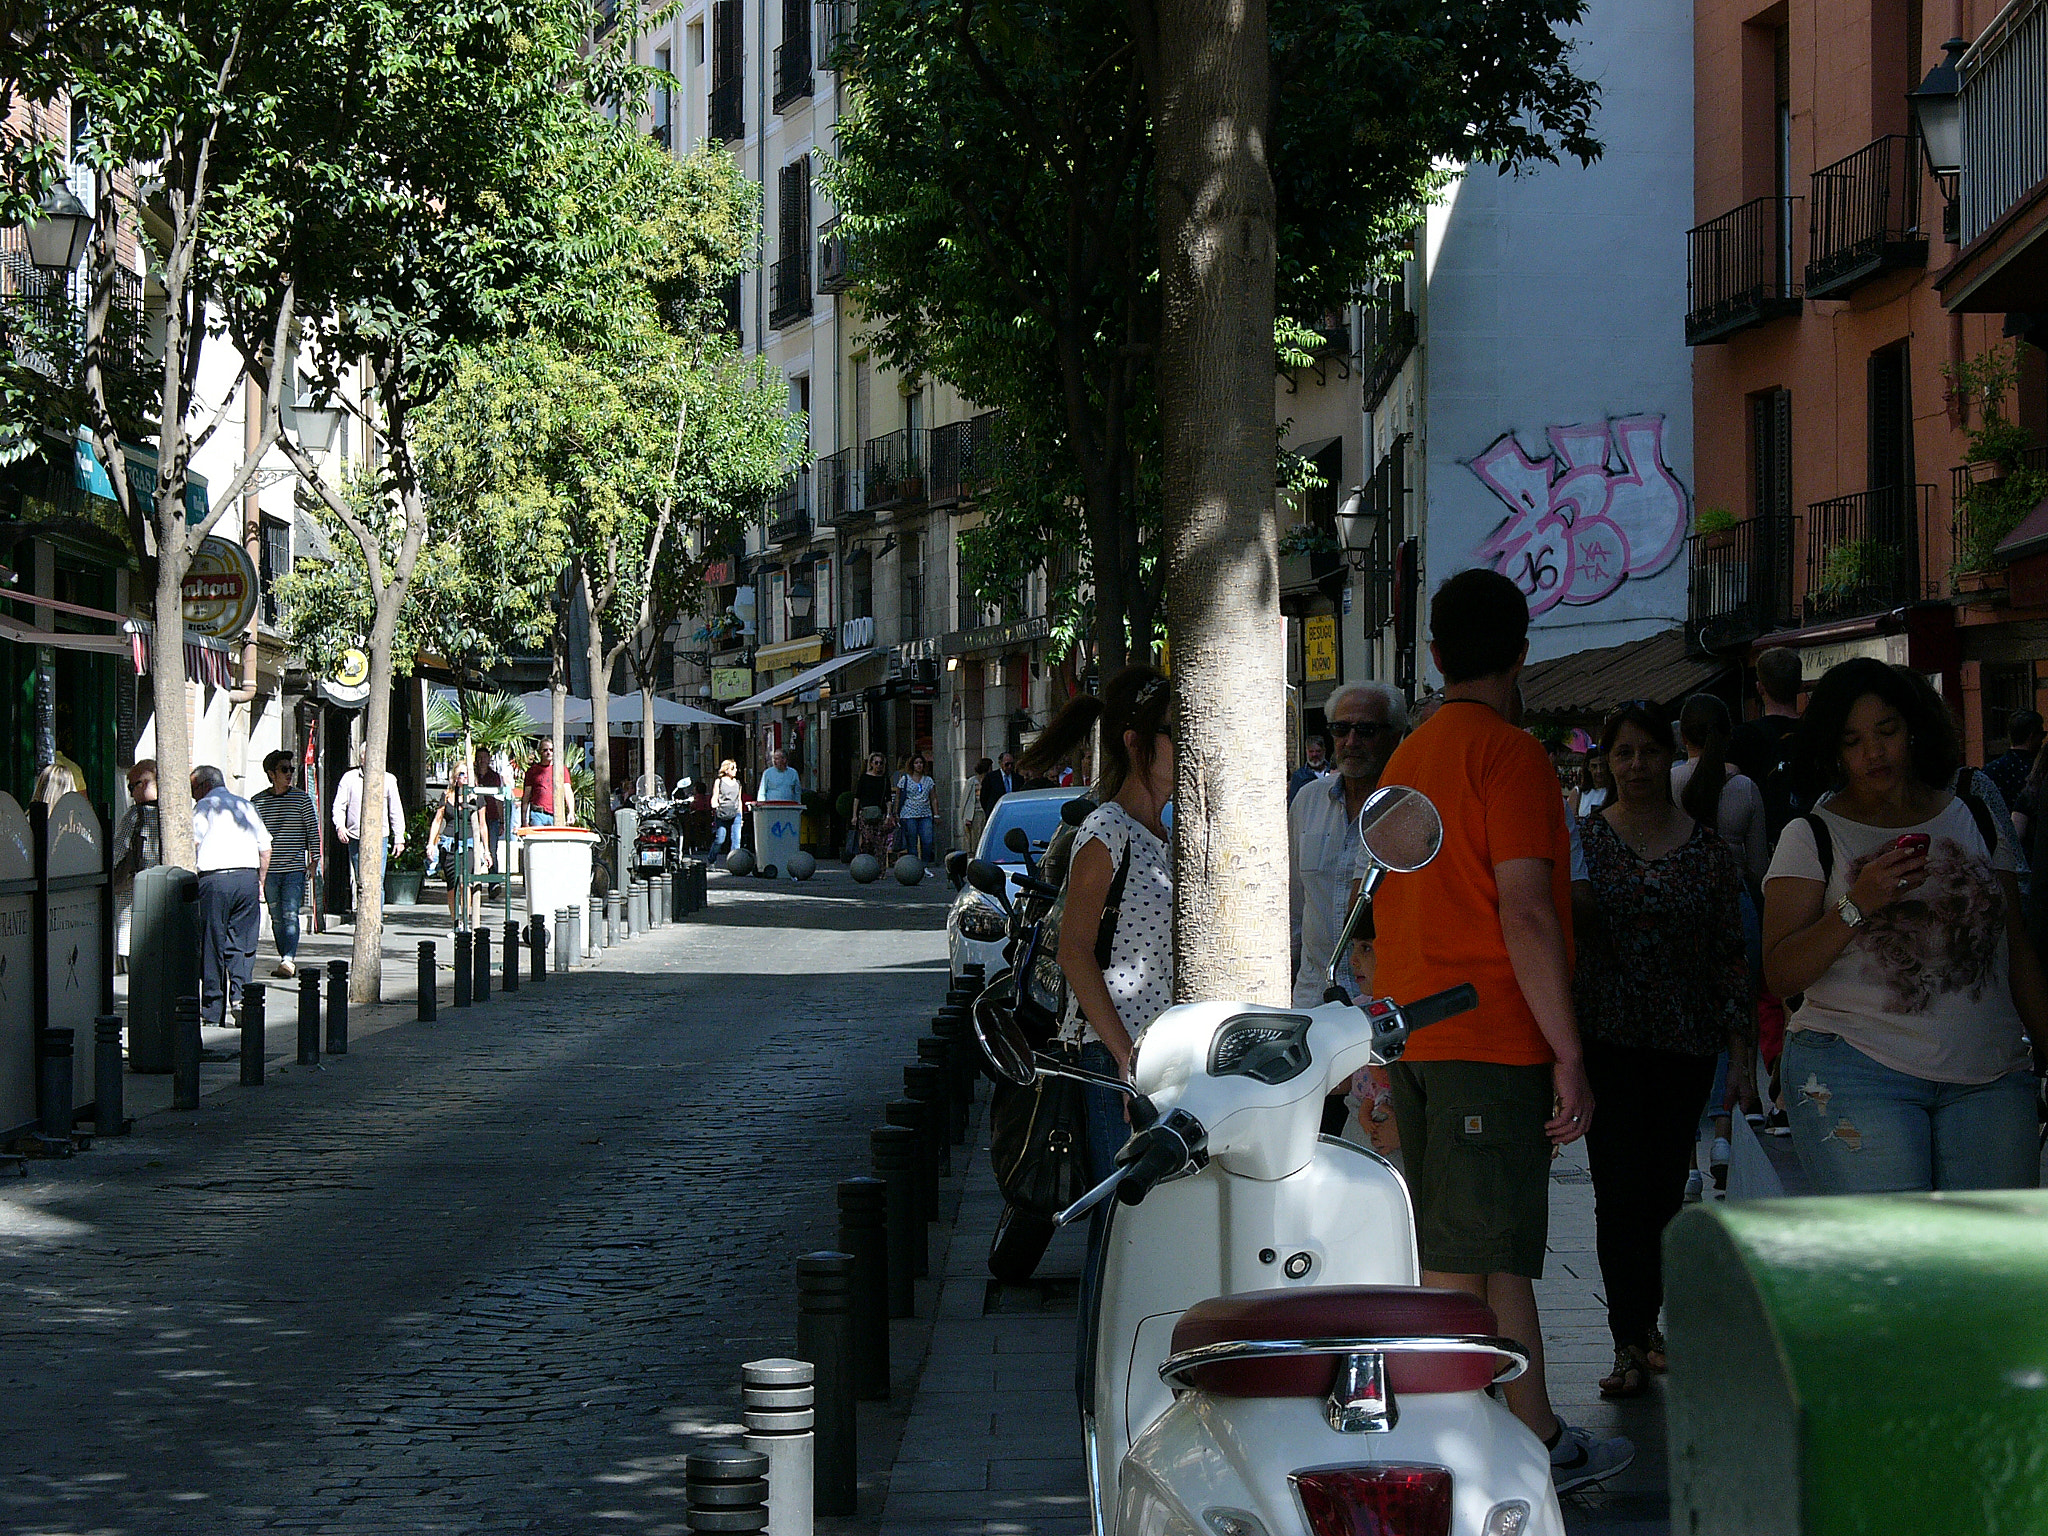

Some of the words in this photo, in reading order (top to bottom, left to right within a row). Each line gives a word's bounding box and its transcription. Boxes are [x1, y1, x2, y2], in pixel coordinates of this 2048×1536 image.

[1579, 540, 1612, 562] YA
[1573, 562, 1610, 582] TA
[183, 579, 237, 597] ahou
[1309, 625, 1332, 641] BESUGO
[1317, 641, 1325, 656] AL
[0, 909, 28, 937] RANTE
